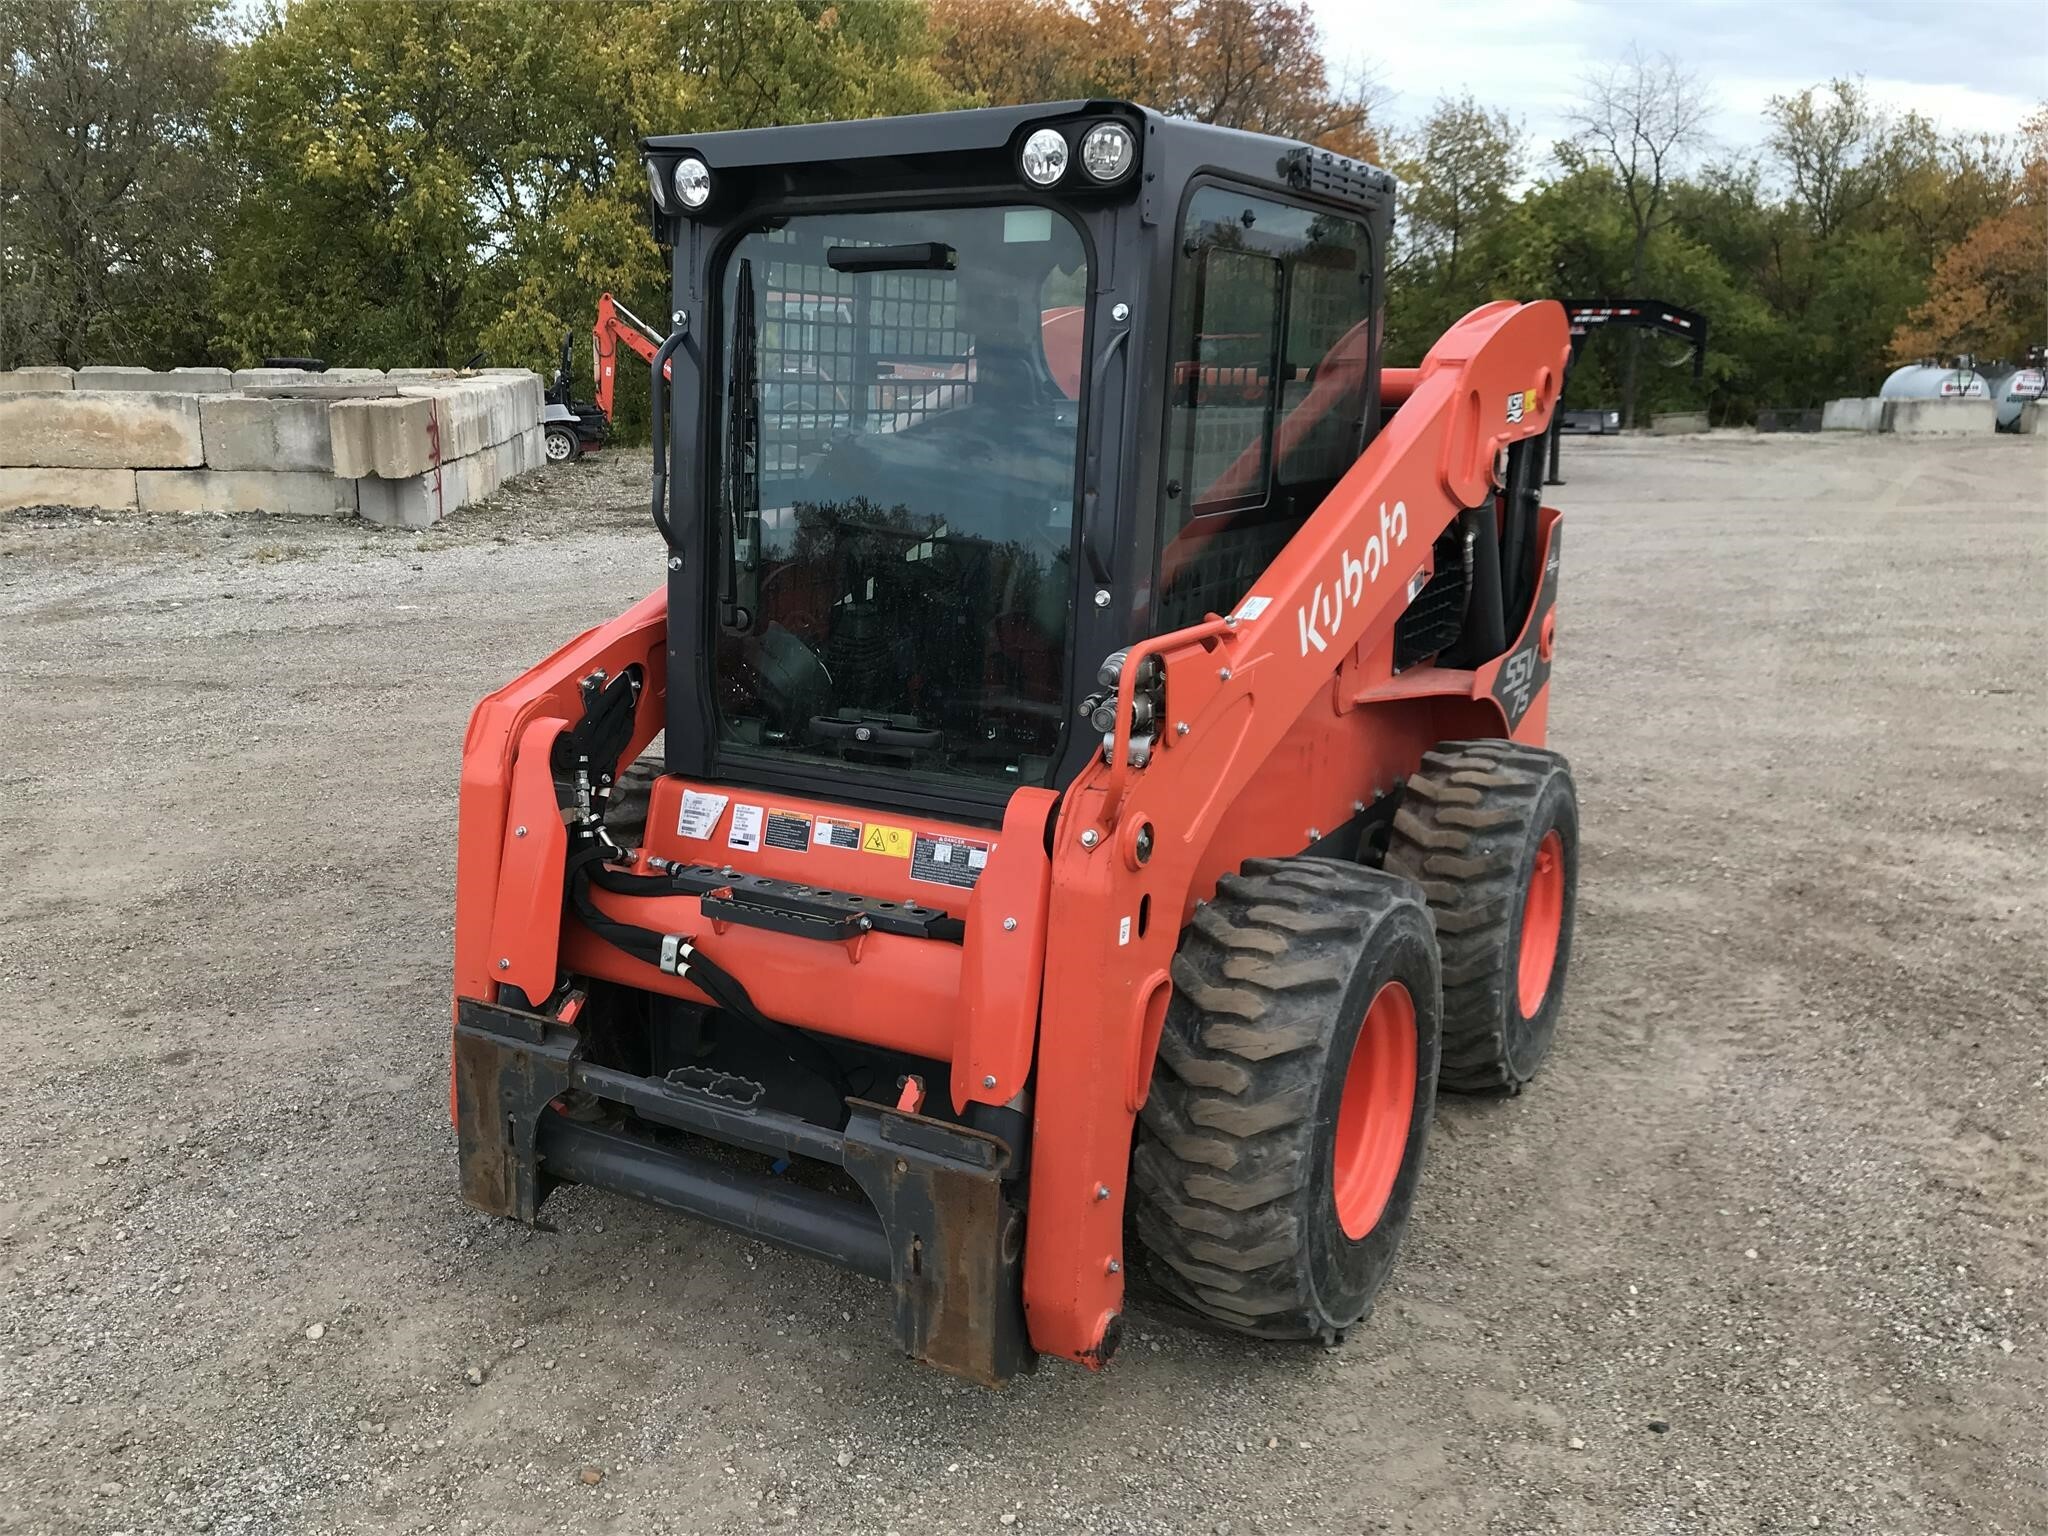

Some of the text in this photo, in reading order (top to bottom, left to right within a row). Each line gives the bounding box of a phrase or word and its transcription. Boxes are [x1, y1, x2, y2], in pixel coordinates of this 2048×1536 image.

[1298, 501, 1408, 657] Kubota
[1502, 643, 1539, 694] SSV
[1512, 683, 1531, 718] 75
[943, 837, 965, 845] DANGER
